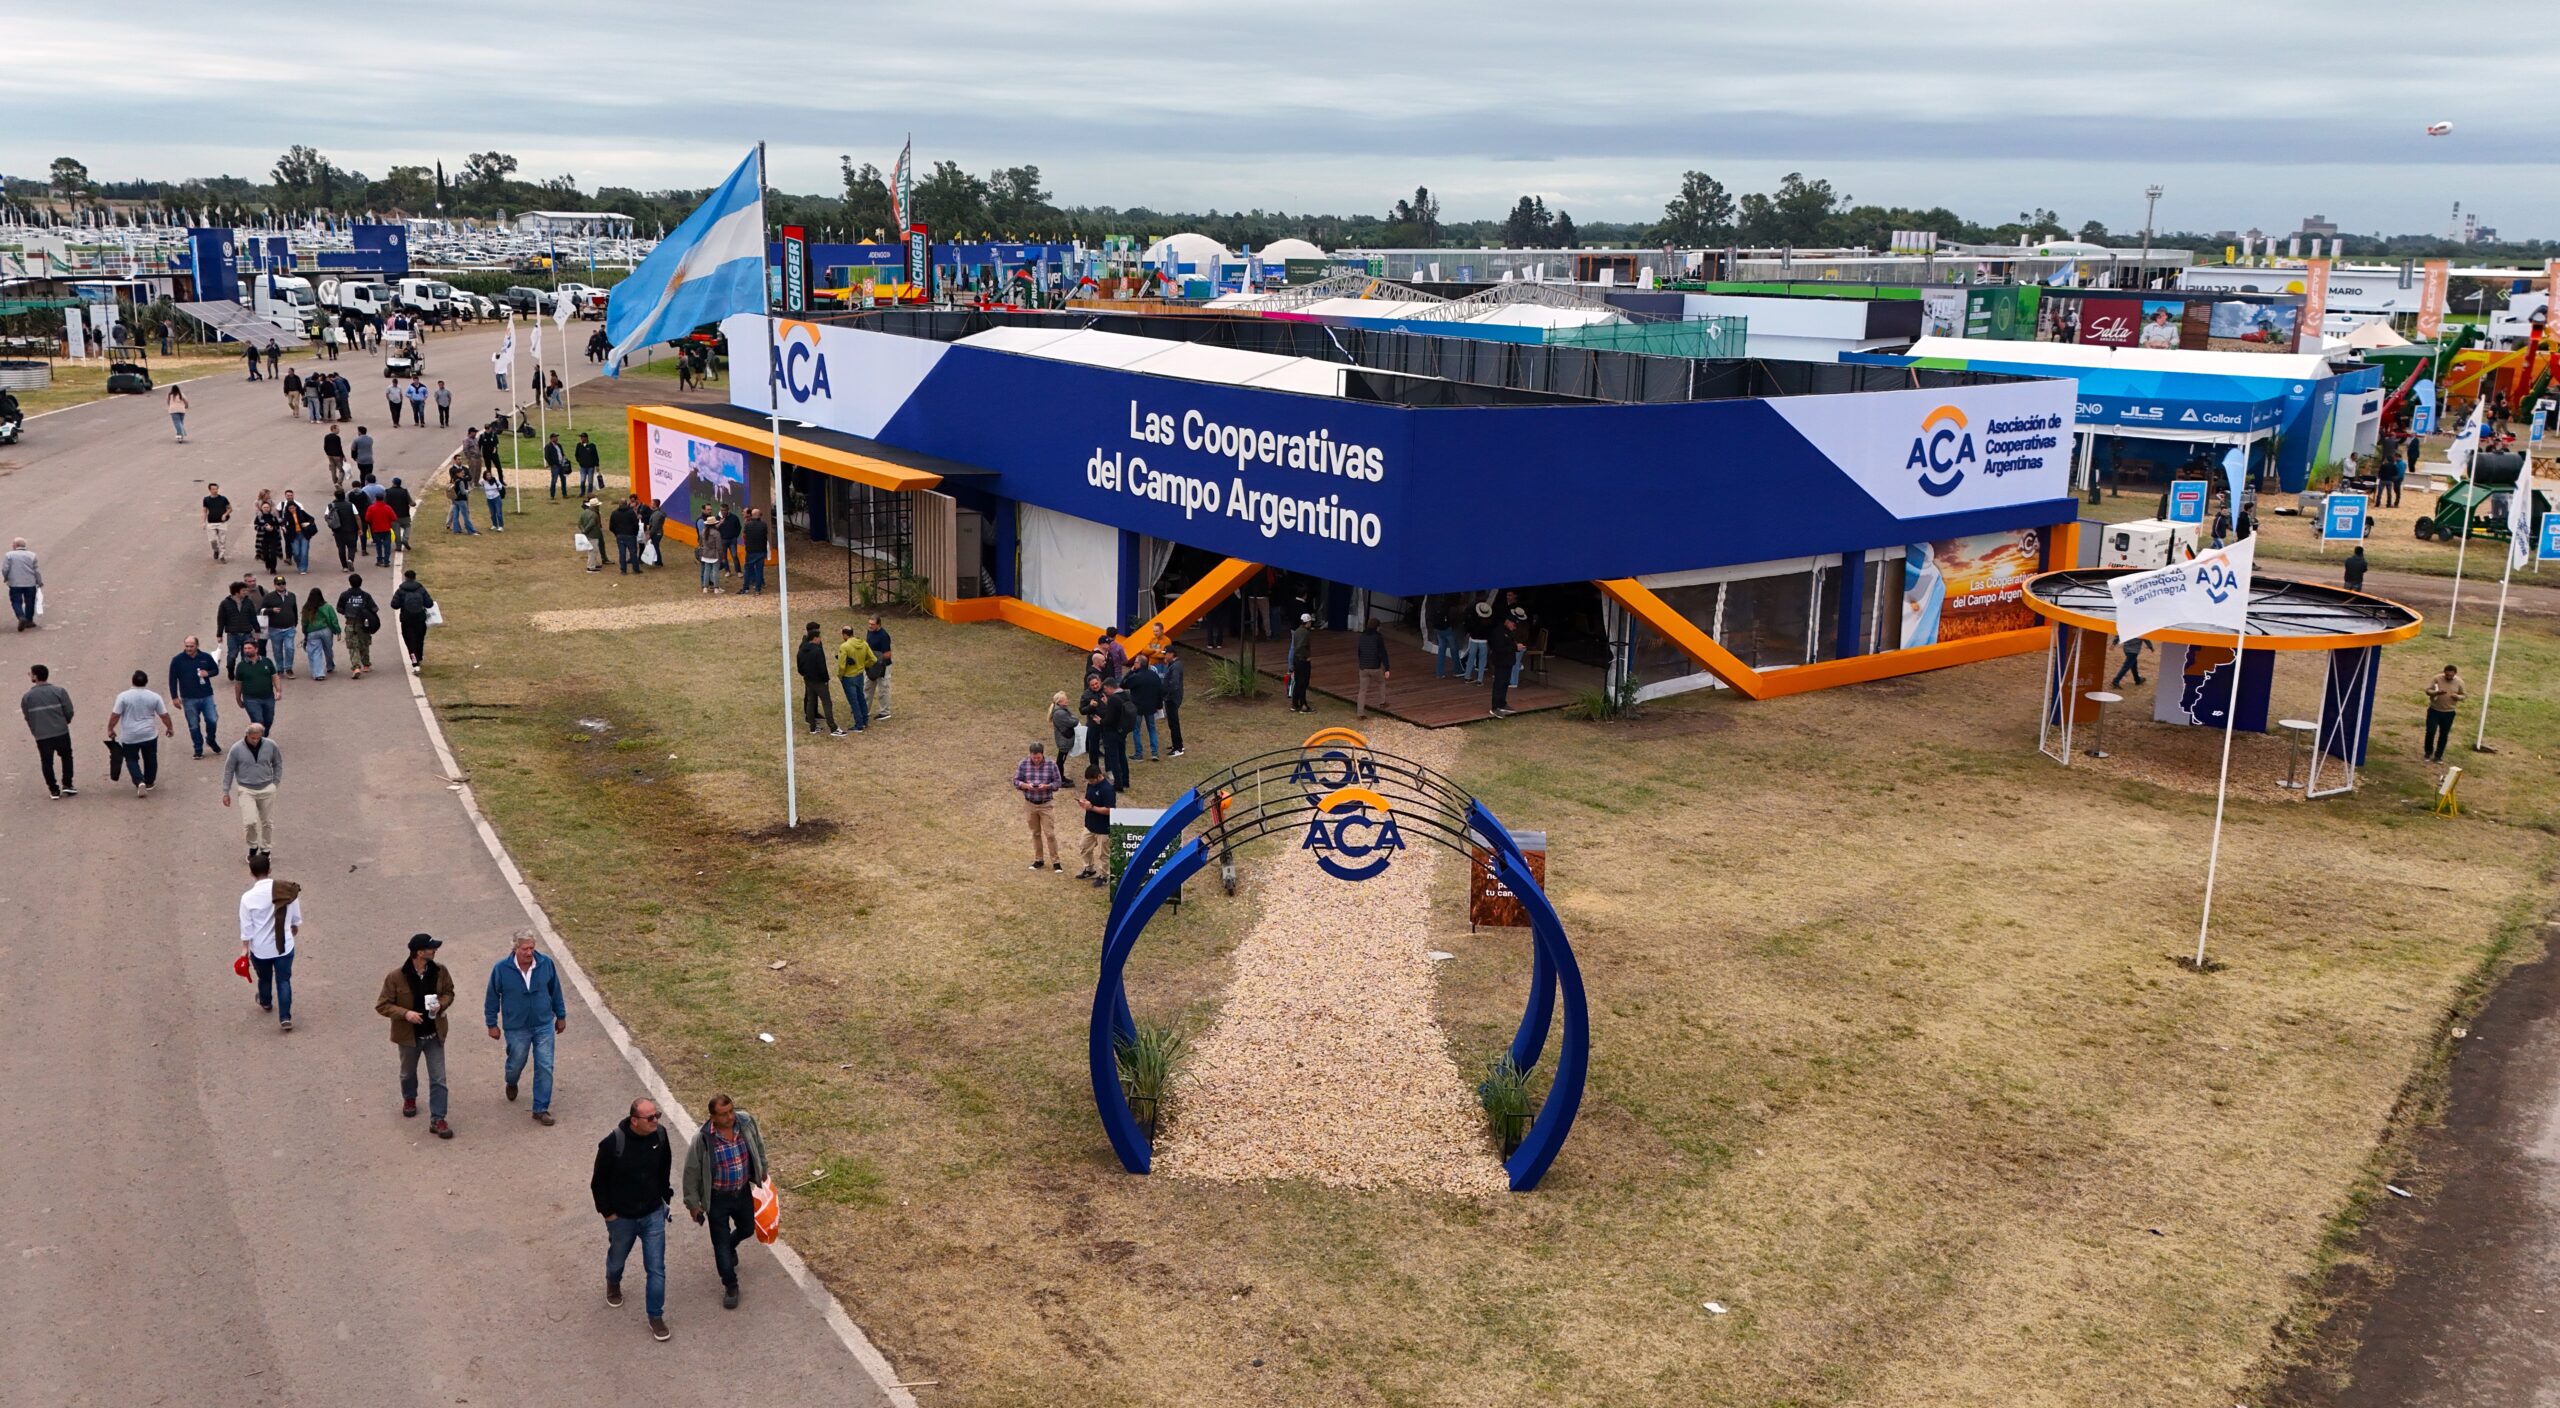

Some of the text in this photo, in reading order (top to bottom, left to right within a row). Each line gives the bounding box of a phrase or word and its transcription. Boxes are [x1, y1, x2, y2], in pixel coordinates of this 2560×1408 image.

[788, 242, 801, 311] CHIGER
[2328, 287, 2363, 296] MARIO
[2086, 316, 2132, 339] Salta
[768, 341, 832, 403] ACA
[2075, 403, 2103, 414] GNO
[2120, 406, 2164, 418] JLS
[1986, 413, 2062, 435] Asociación de
[1129, 399, 1384, 483] Las Cooperativas
[1905, 428, 1976, 474] ACA
[1985, 434, 2057, 456] Cooperativas
[1983, 455, 2043, 477] Argentinas
[1086, 447, 1383, 548] del Campo Argentino
[2017, 535, 2040, 550] ACA
[1970, 579, 1985, 592] Las
[1952, 589, 2022, 609] del Campo Argen
[1301, 815, 1406, 858] ACA
[1485, 889, 1495, 897] tu
